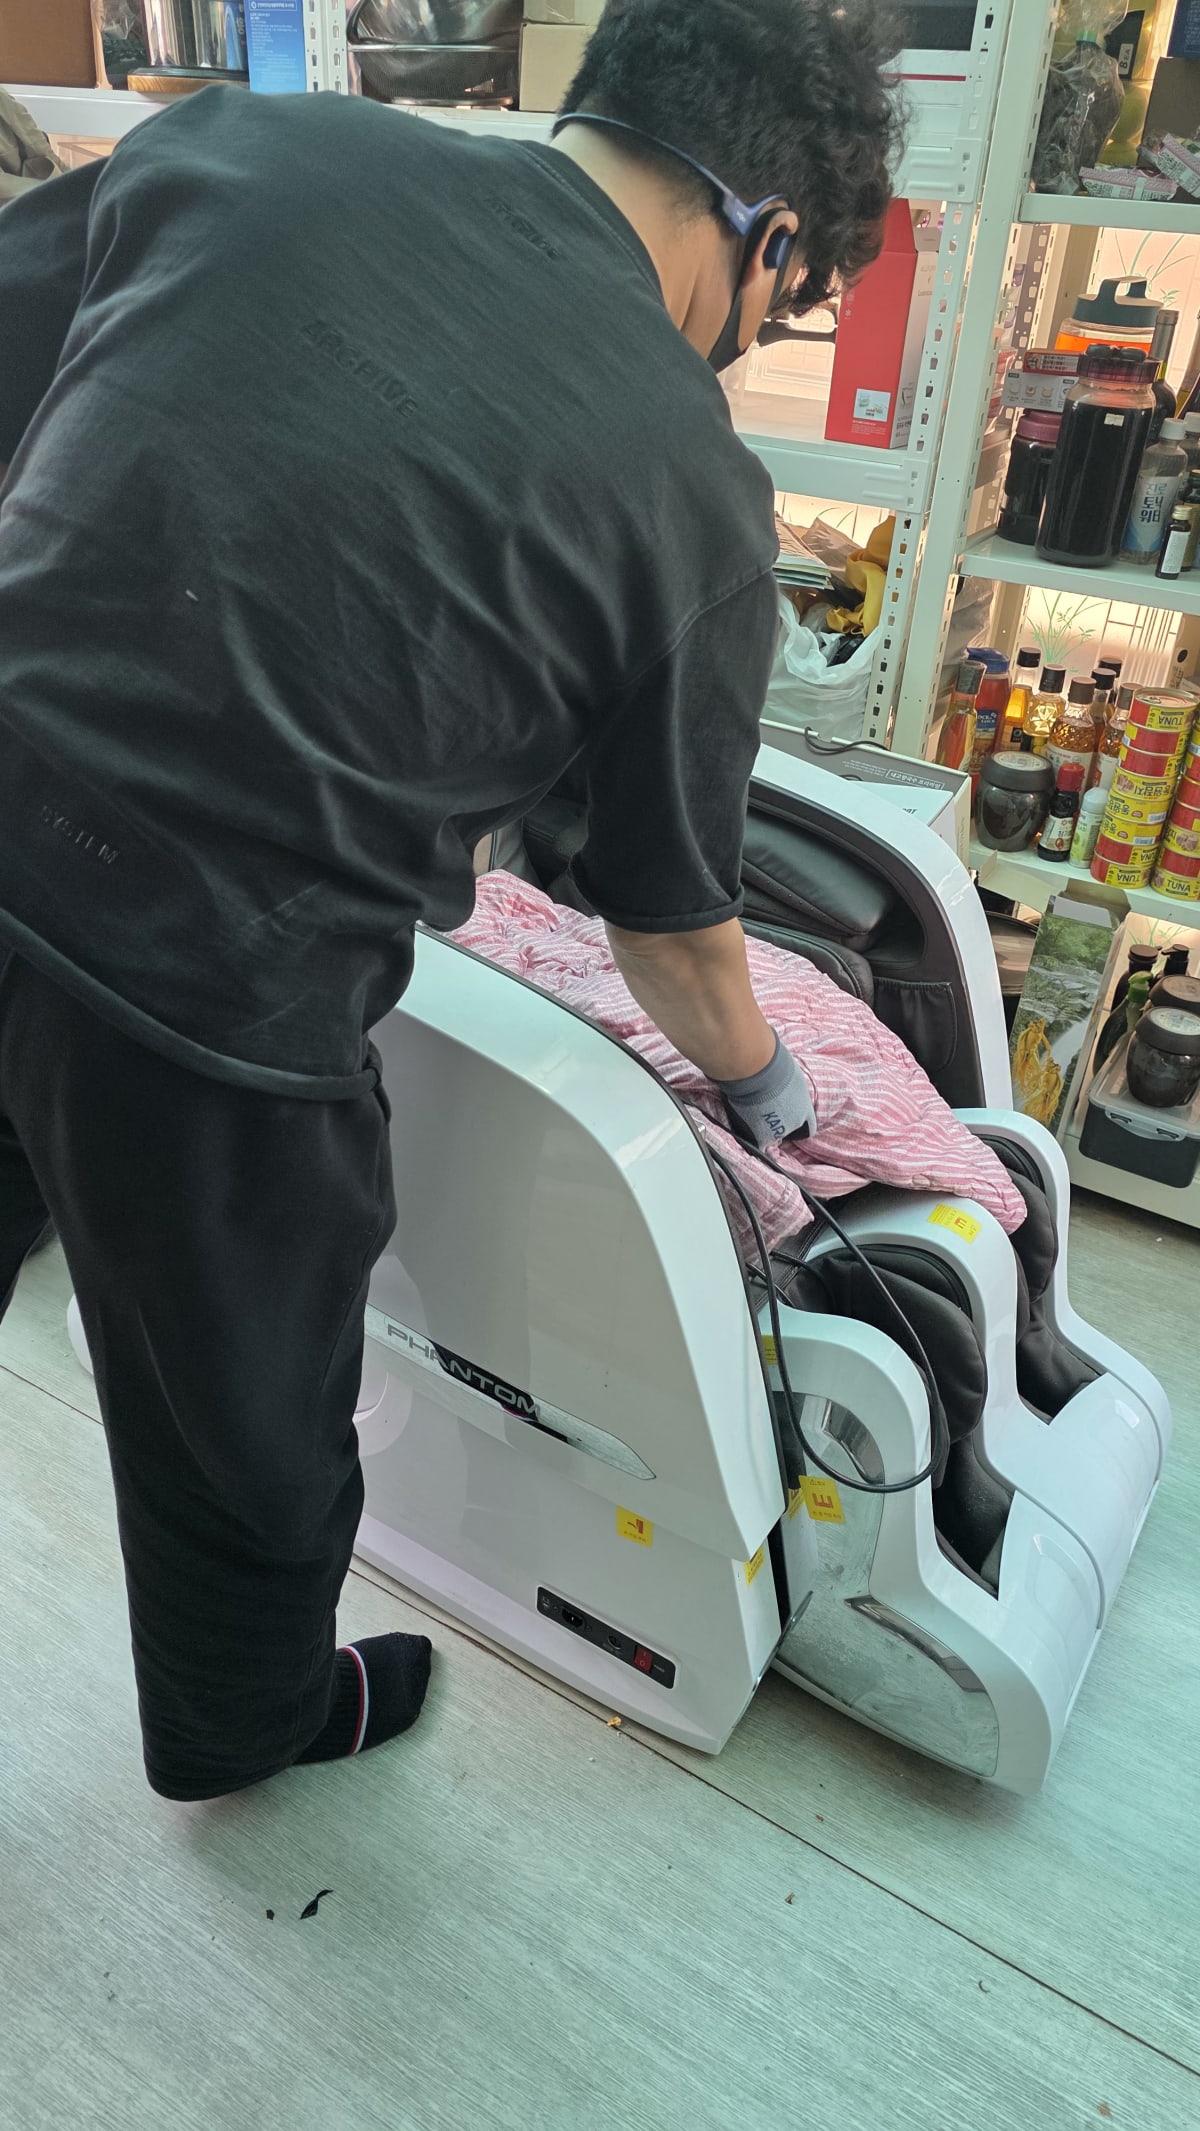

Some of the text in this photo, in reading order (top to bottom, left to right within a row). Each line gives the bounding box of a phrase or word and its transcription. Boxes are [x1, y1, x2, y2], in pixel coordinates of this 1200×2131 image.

[1146, 483, 1167, 496] 진로
[1142, 496, 1164, 510] 토닉
[1139, 509, 1161, 524] 워터
[1158, 714, 1183, 726] TUNA
[1116, 873, 1140, 884] TUNA
[1166, 879, 1192, 892] TUNA
[762, 1111, 786, 1139] KAR
[387, 1323, 542, 1419] PHANTOM
